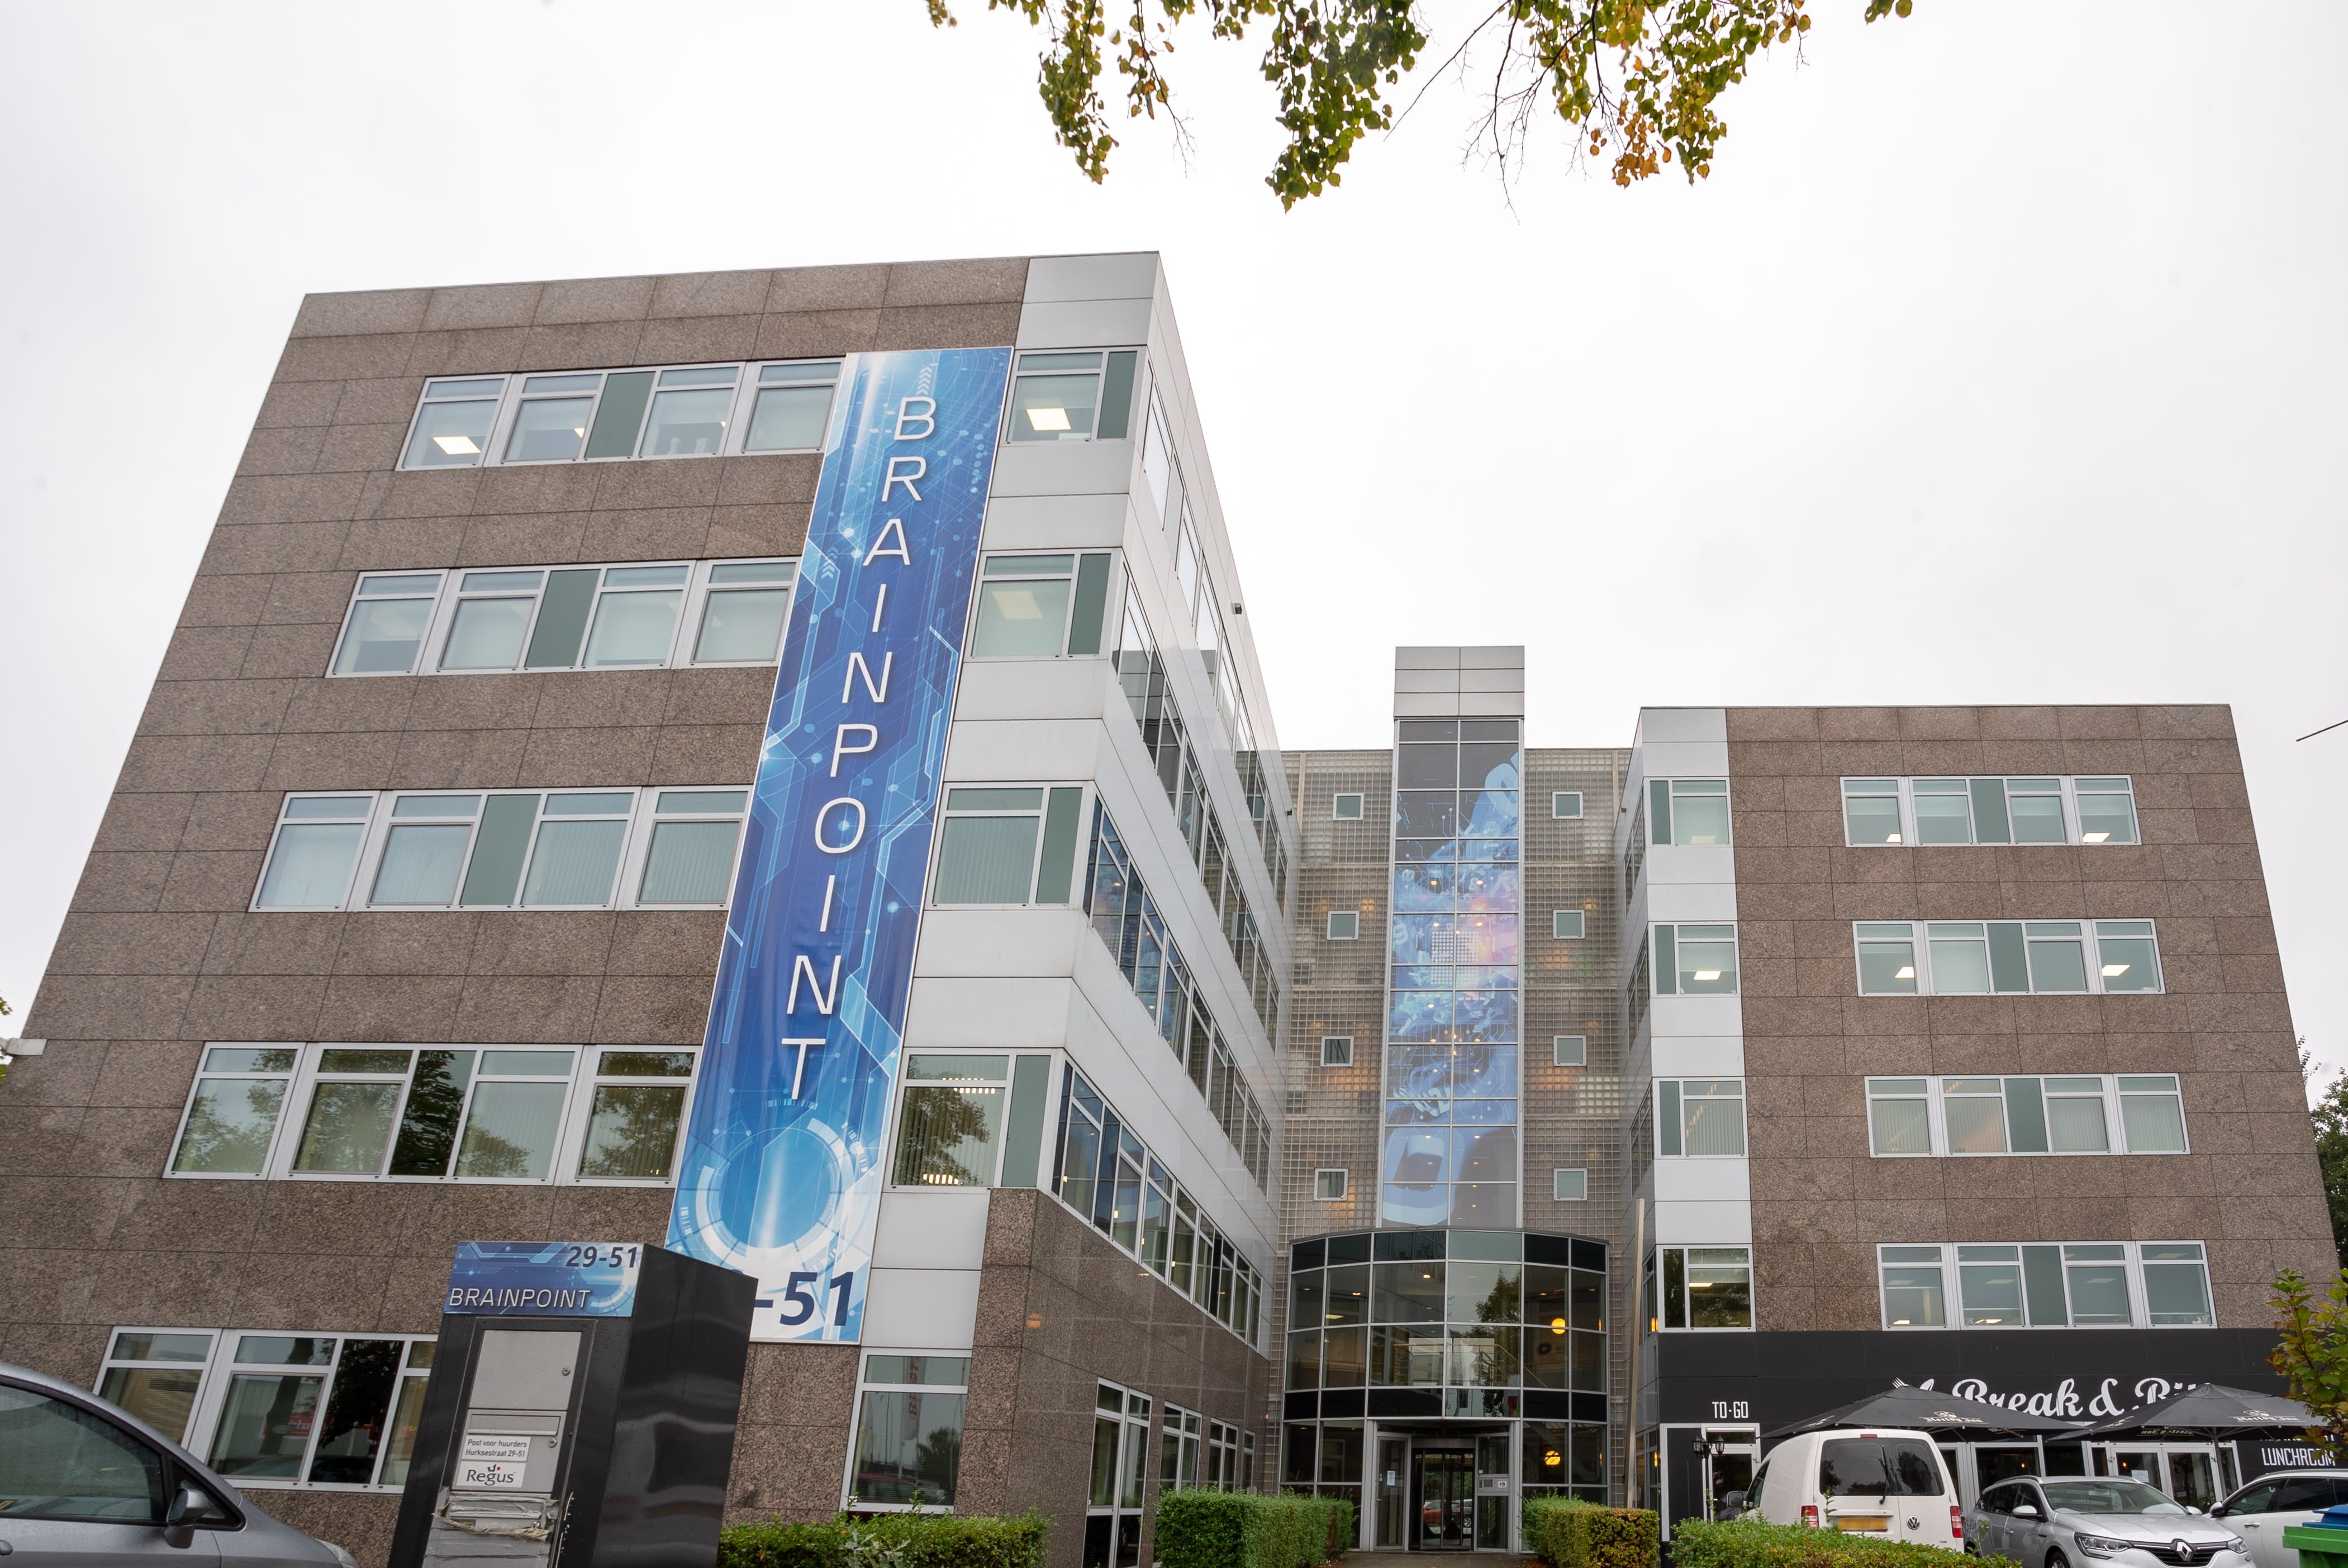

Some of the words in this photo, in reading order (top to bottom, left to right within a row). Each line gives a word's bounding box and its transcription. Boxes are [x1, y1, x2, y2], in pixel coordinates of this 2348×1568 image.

[781, 395, 937, 1100] BRAINPOINT
[565, 1246, 638, 1268] 29-51
[449, 1288, 591, 1308] BRAINPOINT
[728, 1269, 854, 1326] -51
[1952, 1378, 2084, 1417] Break
[1712, 1401, 1748, 1419] TO-GO
[466, 1469, 515, 1486] Regus
